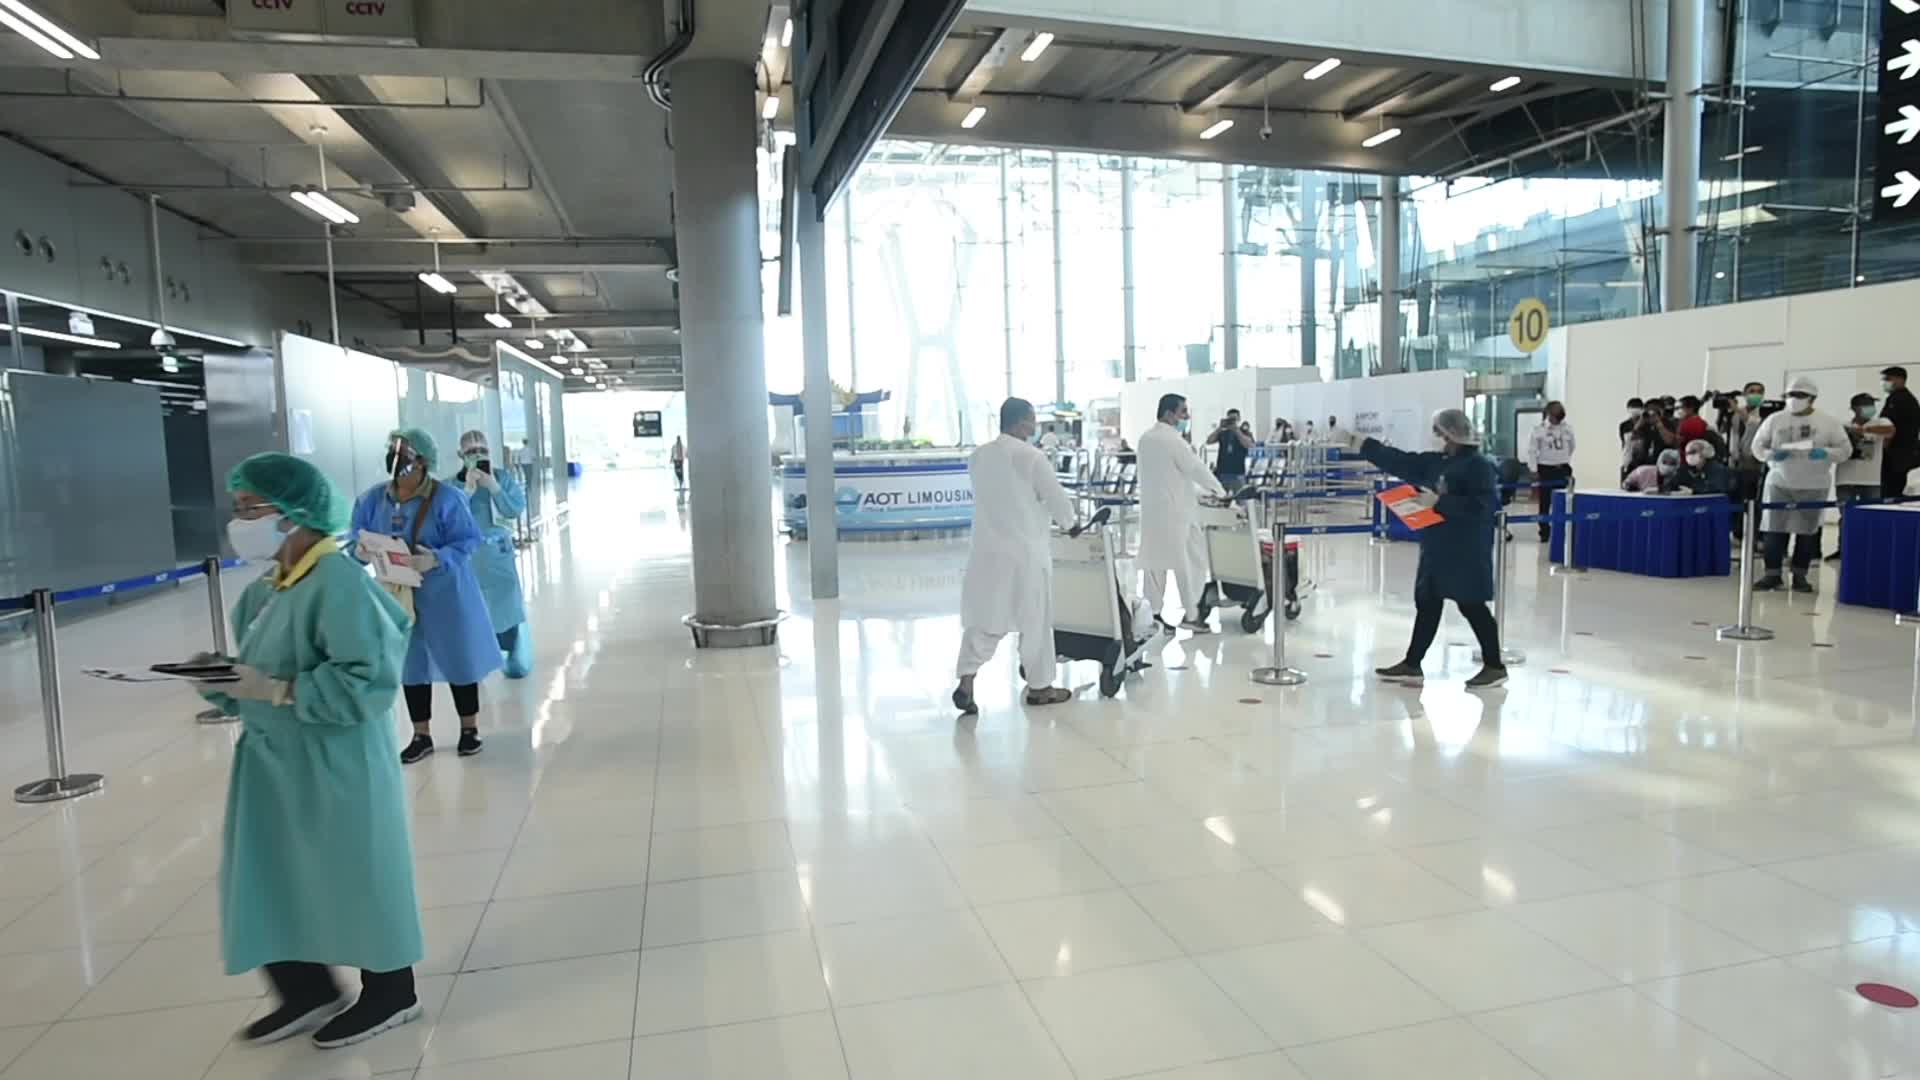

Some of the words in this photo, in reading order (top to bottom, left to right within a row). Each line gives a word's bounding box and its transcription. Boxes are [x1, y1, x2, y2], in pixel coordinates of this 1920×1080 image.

[345, 2, 385, 16] CCTV
[1514, 308, 1543, 344] 10
[864, 492, 903, 505] AOT
